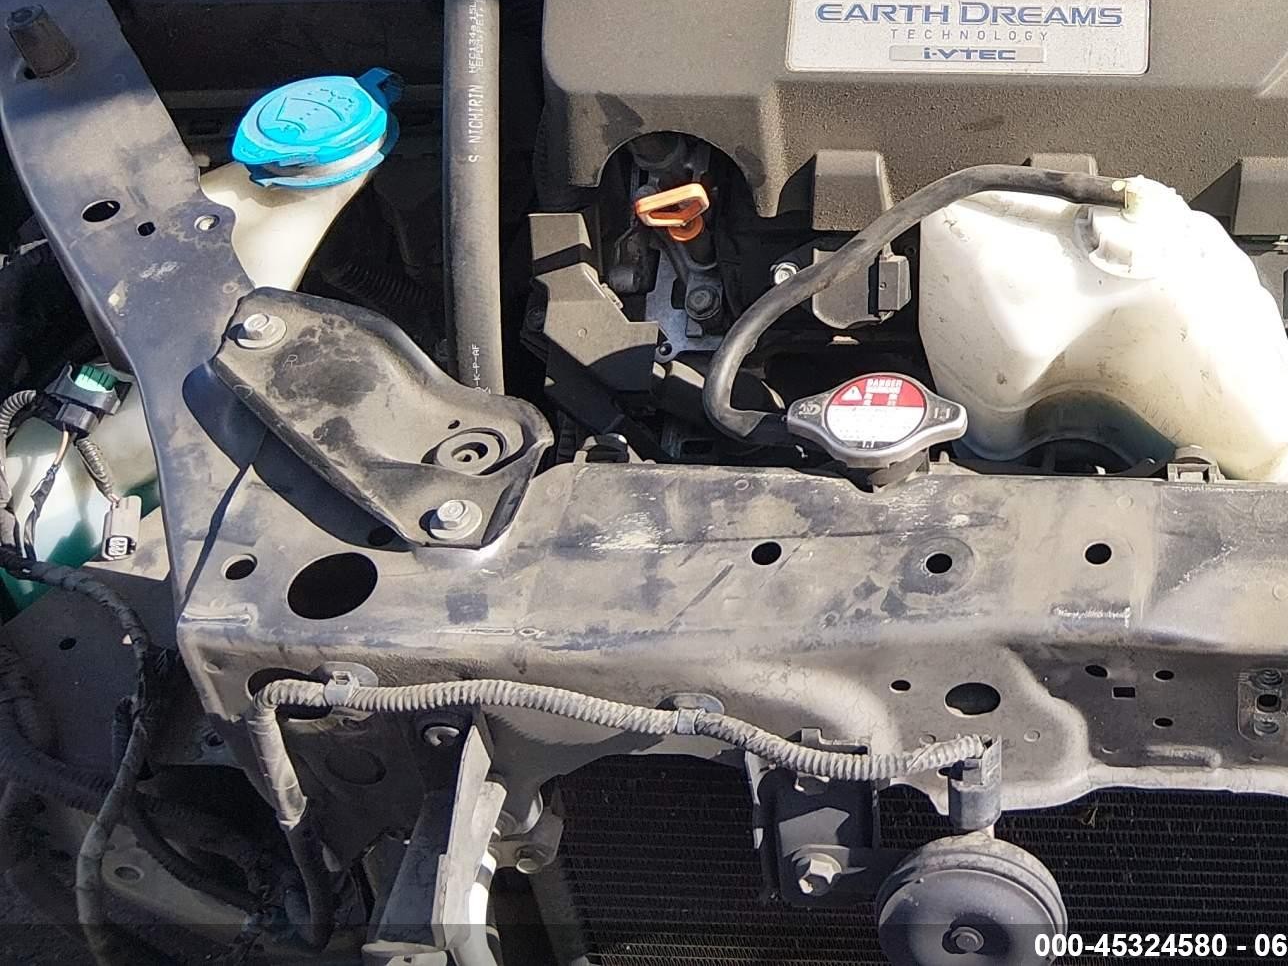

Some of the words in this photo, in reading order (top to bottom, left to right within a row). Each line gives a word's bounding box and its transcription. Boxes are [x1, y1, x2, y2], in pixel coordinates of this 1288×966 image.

[814, 1, 950, 25] EARTH
[958, 0, 1124, 27] DREAMS
[891, 28, 1049, 42] TECHNOLOGY
[922, 47, 1016, 60] i-VTEC
[467, 83, 484, 144] NICHIRIN
[867, 378, 903, 387] DANGER
